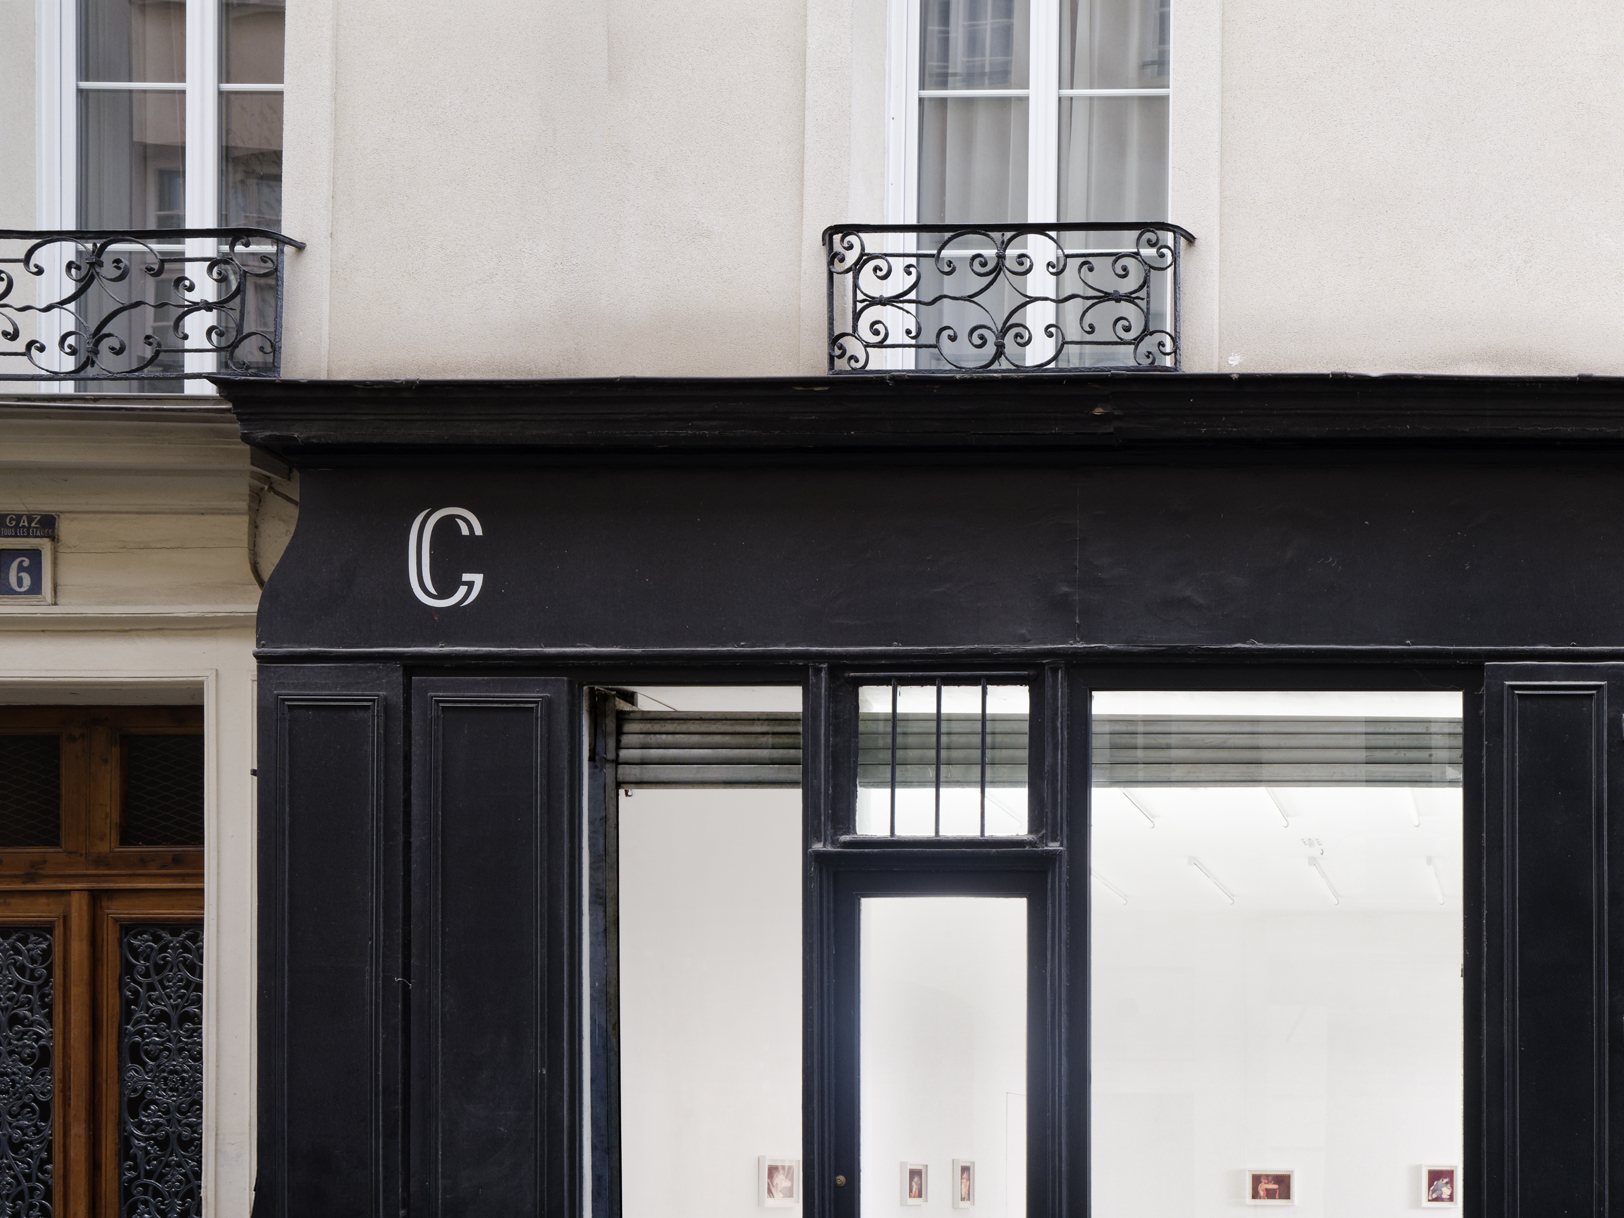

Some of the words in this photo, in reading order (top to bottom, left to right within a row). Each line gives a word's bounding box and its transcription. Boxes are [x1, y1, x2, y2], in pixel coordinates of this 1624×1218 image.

[6, 514, 41, 527] GAZ
[1, 528, 16, 536] TOUS
[17, 528, 28, 536] LES
[8, 557, 31, 592] 6
